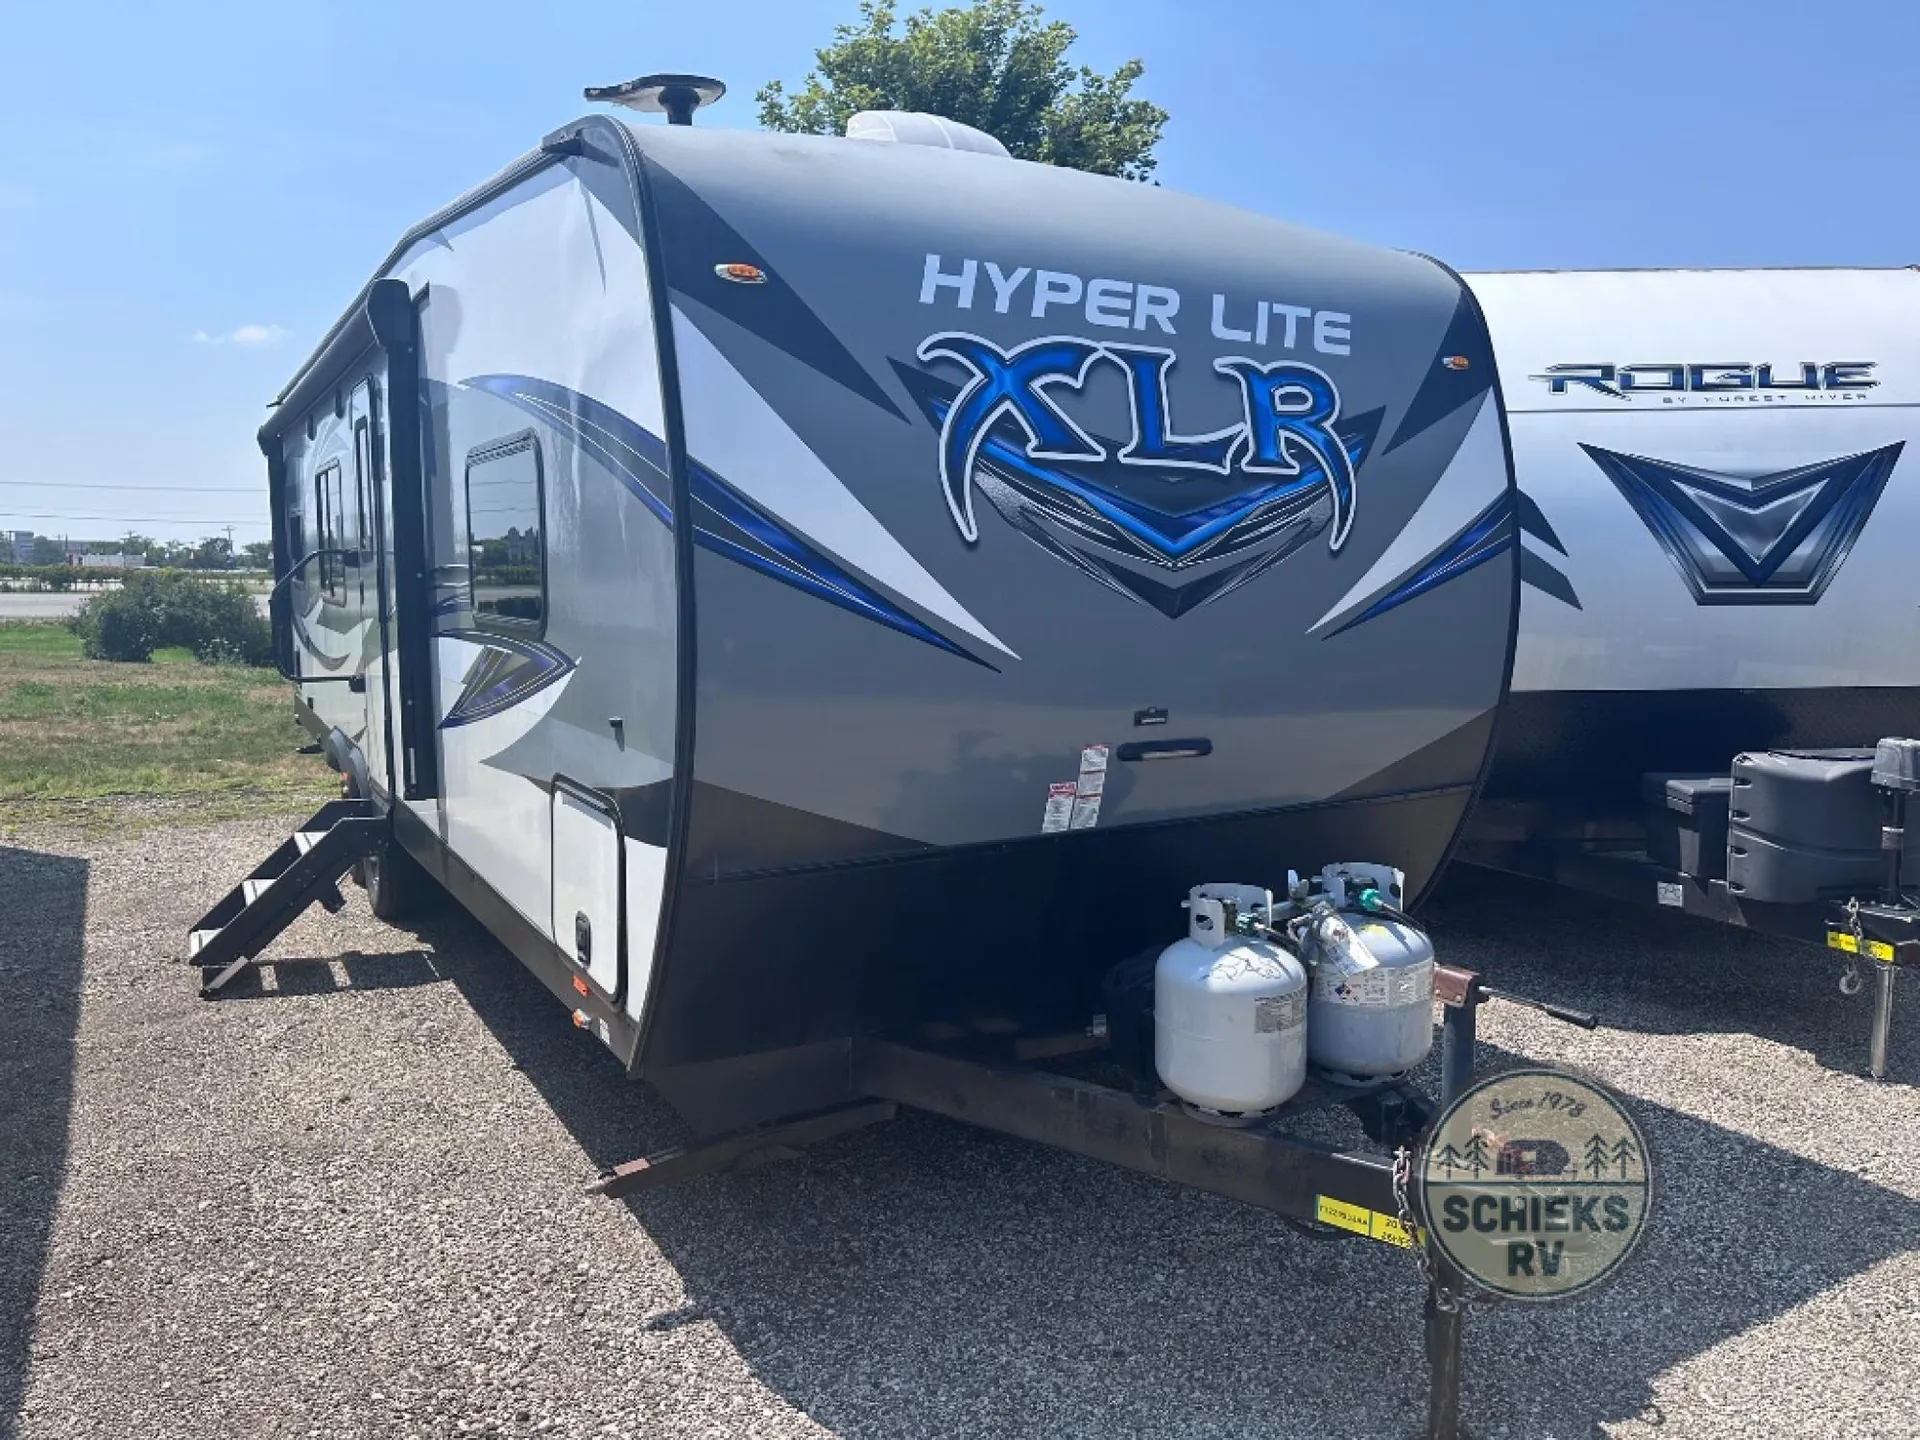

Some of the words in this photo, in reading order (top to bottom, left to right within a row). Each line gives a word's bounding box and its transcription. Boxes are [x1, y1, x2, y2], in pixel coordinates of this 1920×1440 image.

[918, 253, 1181, 335] HYPER
[1211, 293, 1352, 356] LITE
[1528, 361, 1881, 402] ROGUE
[917, 331, 1357, 555] XLR
